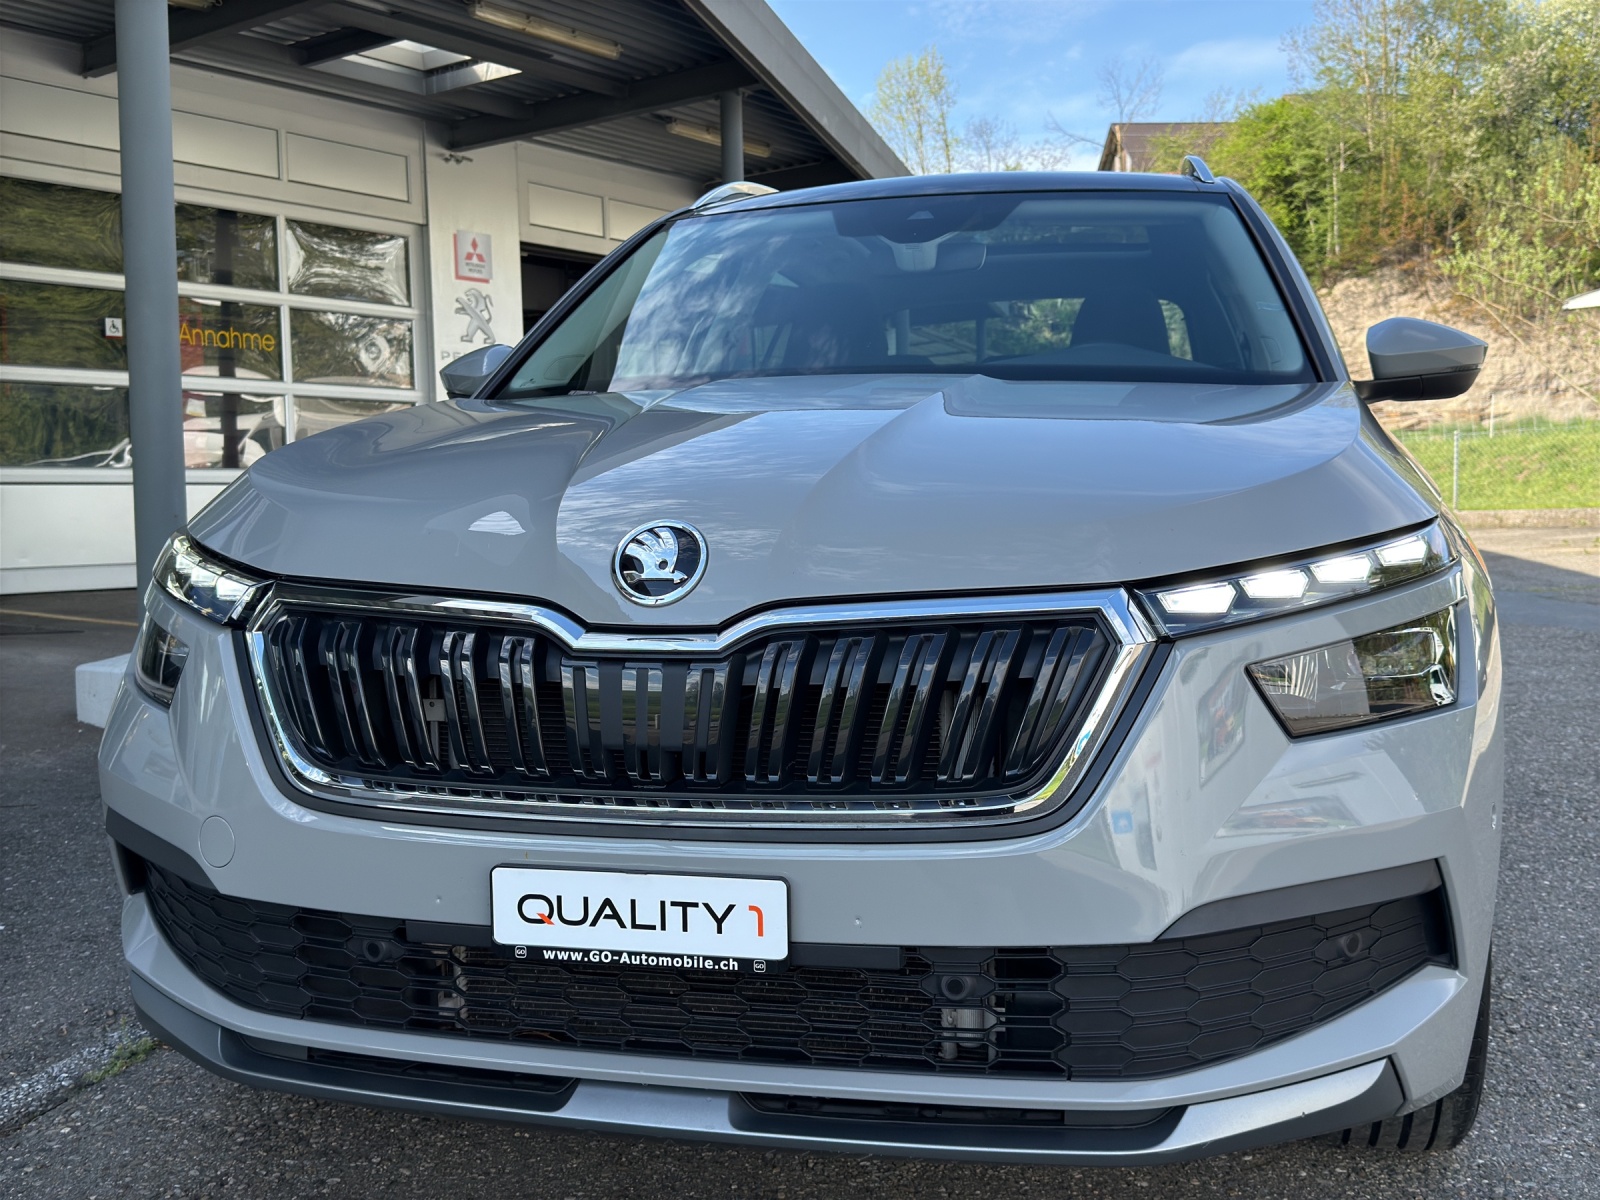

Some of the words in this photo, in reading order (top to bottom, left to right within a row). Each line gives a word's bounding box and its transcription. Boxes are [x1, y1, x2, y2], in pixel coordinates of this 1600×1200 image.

[179, 323, 275, 351] Annahme
[517, 893, 736, 934] QUALITY
[748, 905, 764, 937] 1
[543, 950, 738, 970] www.GO-Automobile.ch
